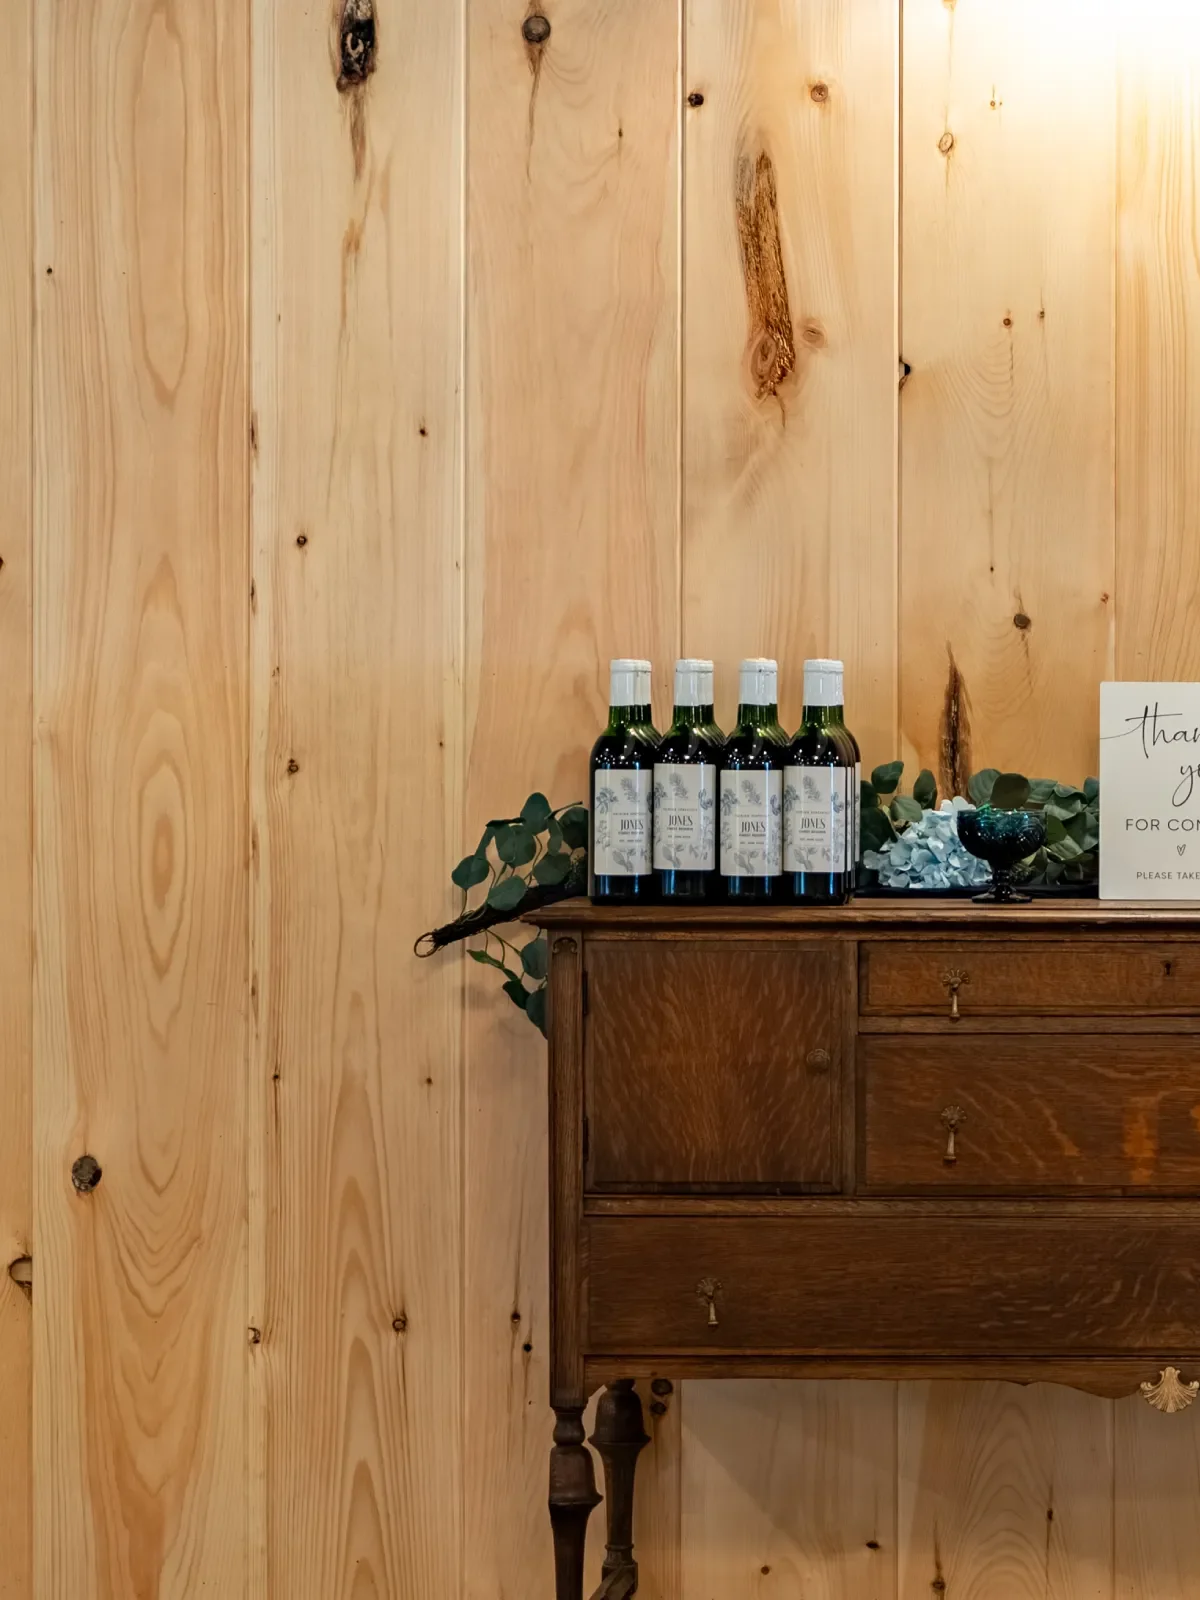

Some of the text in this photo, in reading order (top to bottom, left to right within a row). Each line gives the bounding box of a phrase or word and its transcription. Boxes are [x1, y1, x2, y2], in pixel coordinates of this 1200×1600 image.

[620, 820, 643, 830] JONES
[669, 815, 693, 826] JONES
[801, 818, 825, 829] JONES
[1125, 819, 1160, 831] FOR
[742, 822, 766, 832] JONES
[1136, 871, 1173, 880] PLEASE
[1177, 871, 1200, 880] TAKE
